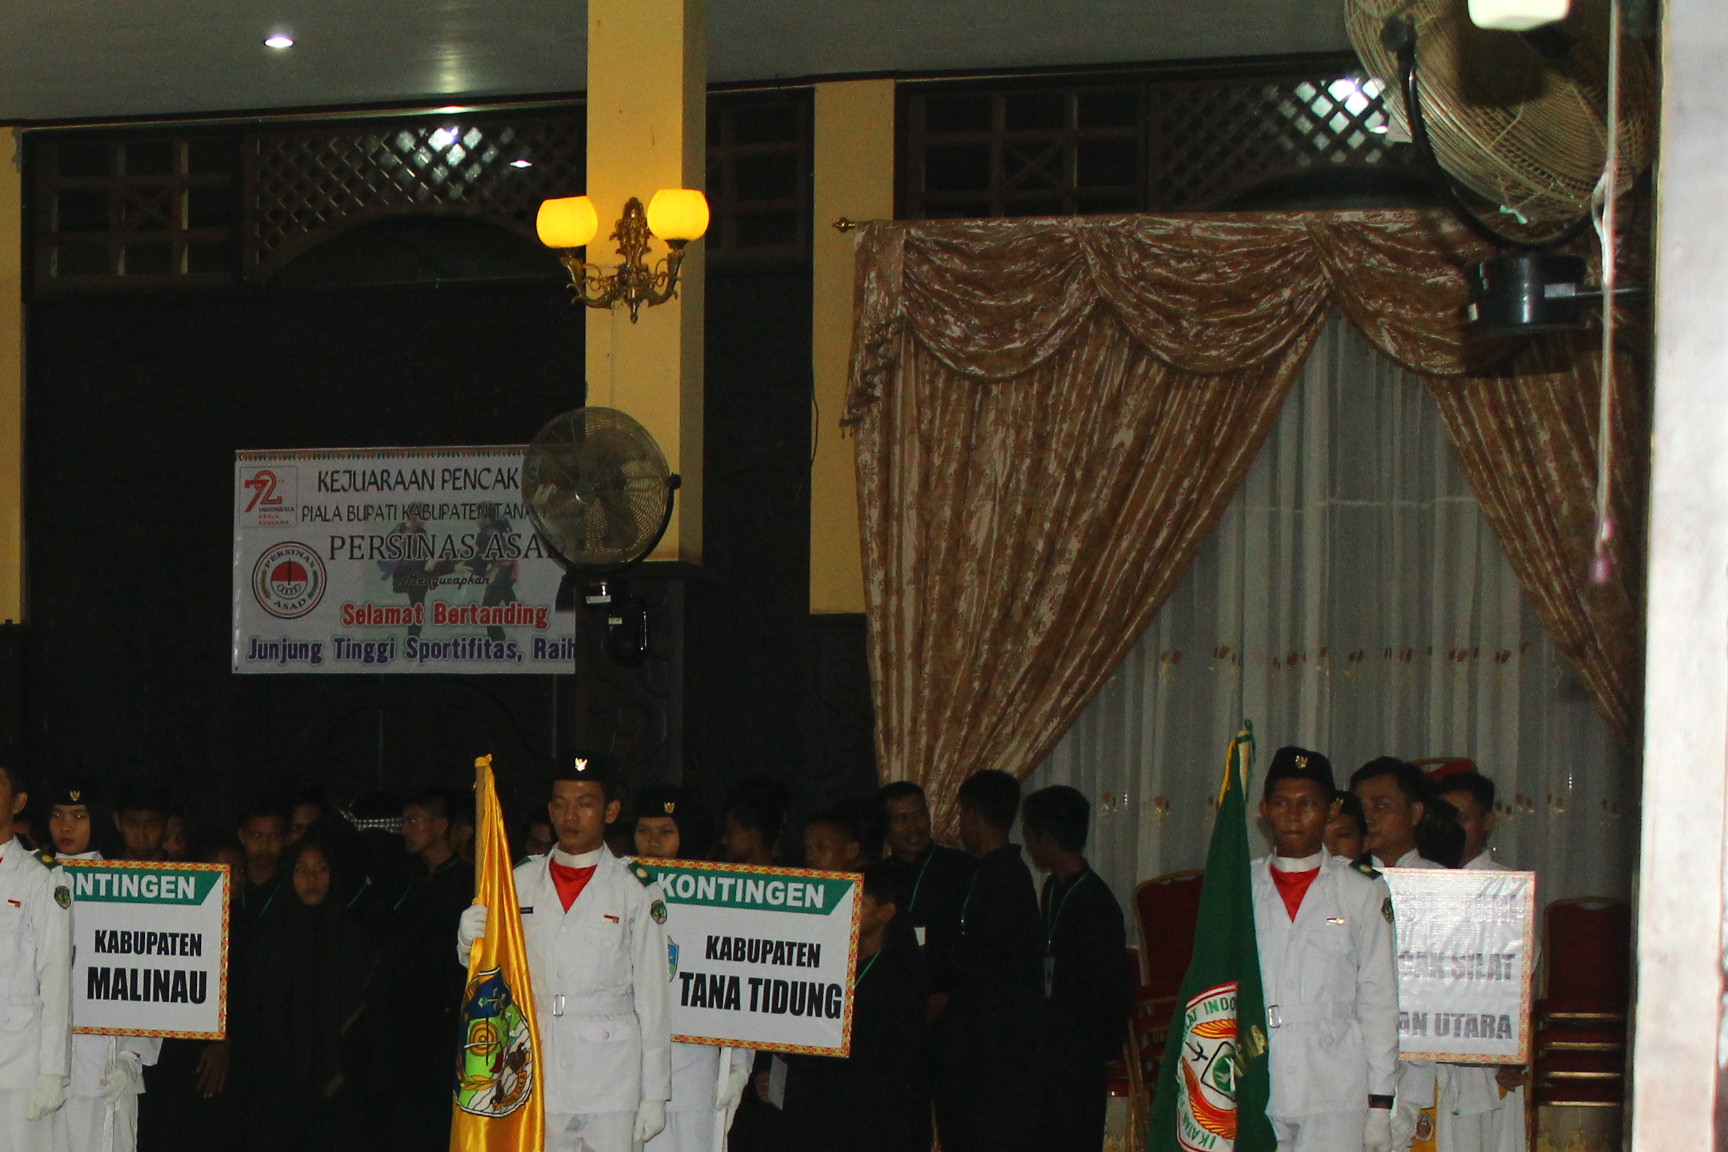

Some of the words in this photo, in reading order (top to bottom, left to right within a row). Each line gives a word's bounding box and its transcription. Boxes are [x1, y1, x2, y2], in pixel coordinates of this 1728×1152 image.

[318, 468, 435, 492] KEJUARAAN
[441, 467, 520, 491] PENCAK
[302, 504, 342, 522] PIALA
[348, 504, 398, 522] BUPATI
[404, 503, 488, 522] KABUPATEN
[494, 502, 530, 520] TAN
[264, 549, 314, 568] PERSINAS
[329, 534, 475, 562] PERSINAS
[483, 533, 556, 561] ASA
[400, 573, 490, 591] Mengucapkan
[274, 598, 306, 610] ASAD
[342, 602, 425, 626] Selamat
[434, 602, 548, 629] Bertanding
[248, 638, 323, 664] Junjung
[334, 637, 396, 664] Tinggi
[406, 636, 523, 663] Sportifitas,
[71, 872, 196, 900] NTINGEN
[657, 872, 825, 908] KONTINGEN
[94, 929, 202, 957] KABUPATEN
[705, 935, 822, 968] KABUPATEN
[1451, 952, 1516, 981] SILAT
[87, 966, 208, 1004] MALINAU
[679, 971, 741, 1010] TANA
[748, 977, 842, 1019] TIDUNG
[1434, 1012, 1512, 1039] UTARA
